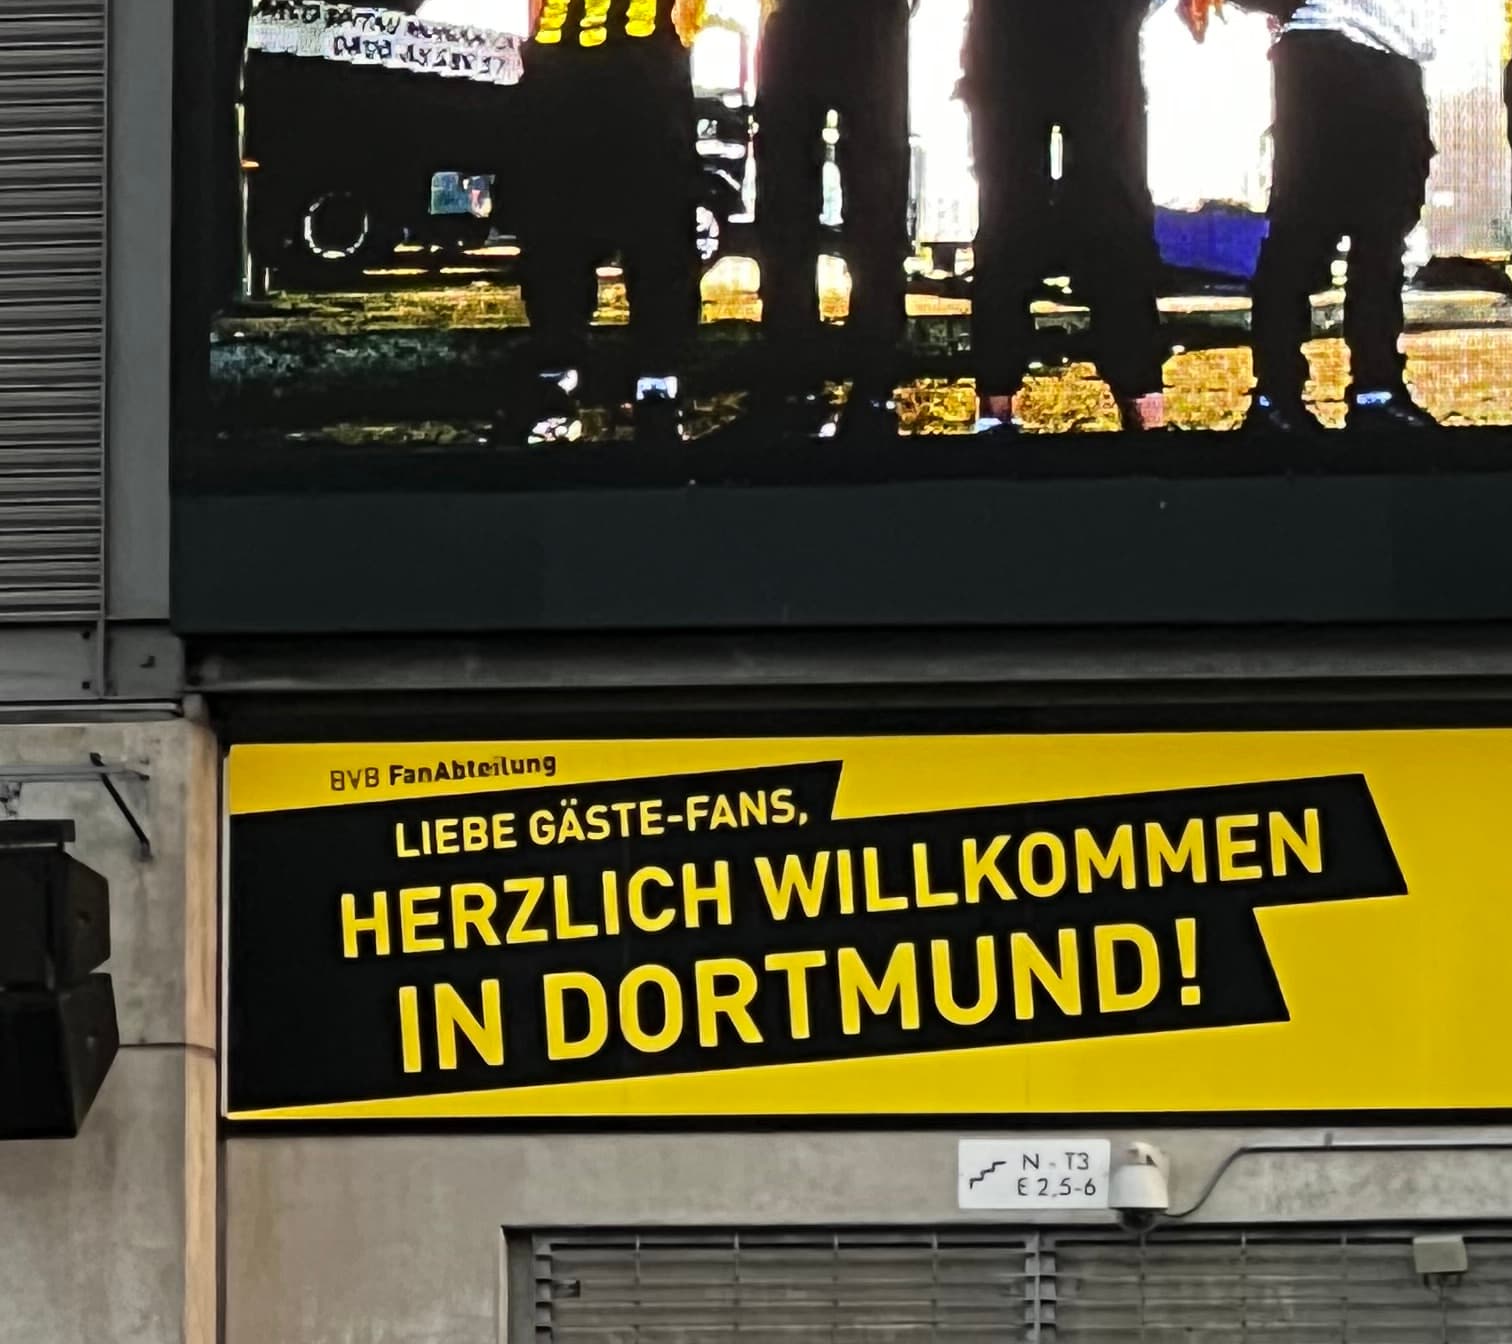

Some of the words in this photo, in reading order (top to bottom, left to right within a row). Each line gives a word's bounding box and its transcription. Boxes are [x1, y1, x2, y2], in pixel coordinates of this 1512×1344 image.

[330, 766, 380, 792] BVB
[389, 755, 557, 786] FanAbteilung
[396, 812, 518, 858] LIEBE
[528, 787, 809, 847] GÄSTE-FANS,
[340, 858, 734, 959] HERZLICH
[753, 806, 1324, 922] WILLKOMMEN
[398, 977, 505, 1074] IN
[542, 917, 1202, 1062] DORTMUND!
[1017, 1176, 1028, 1196] E
[1022, 1152, 1040, 1171] N
[1064, 1151, 1089, 1171] T3
